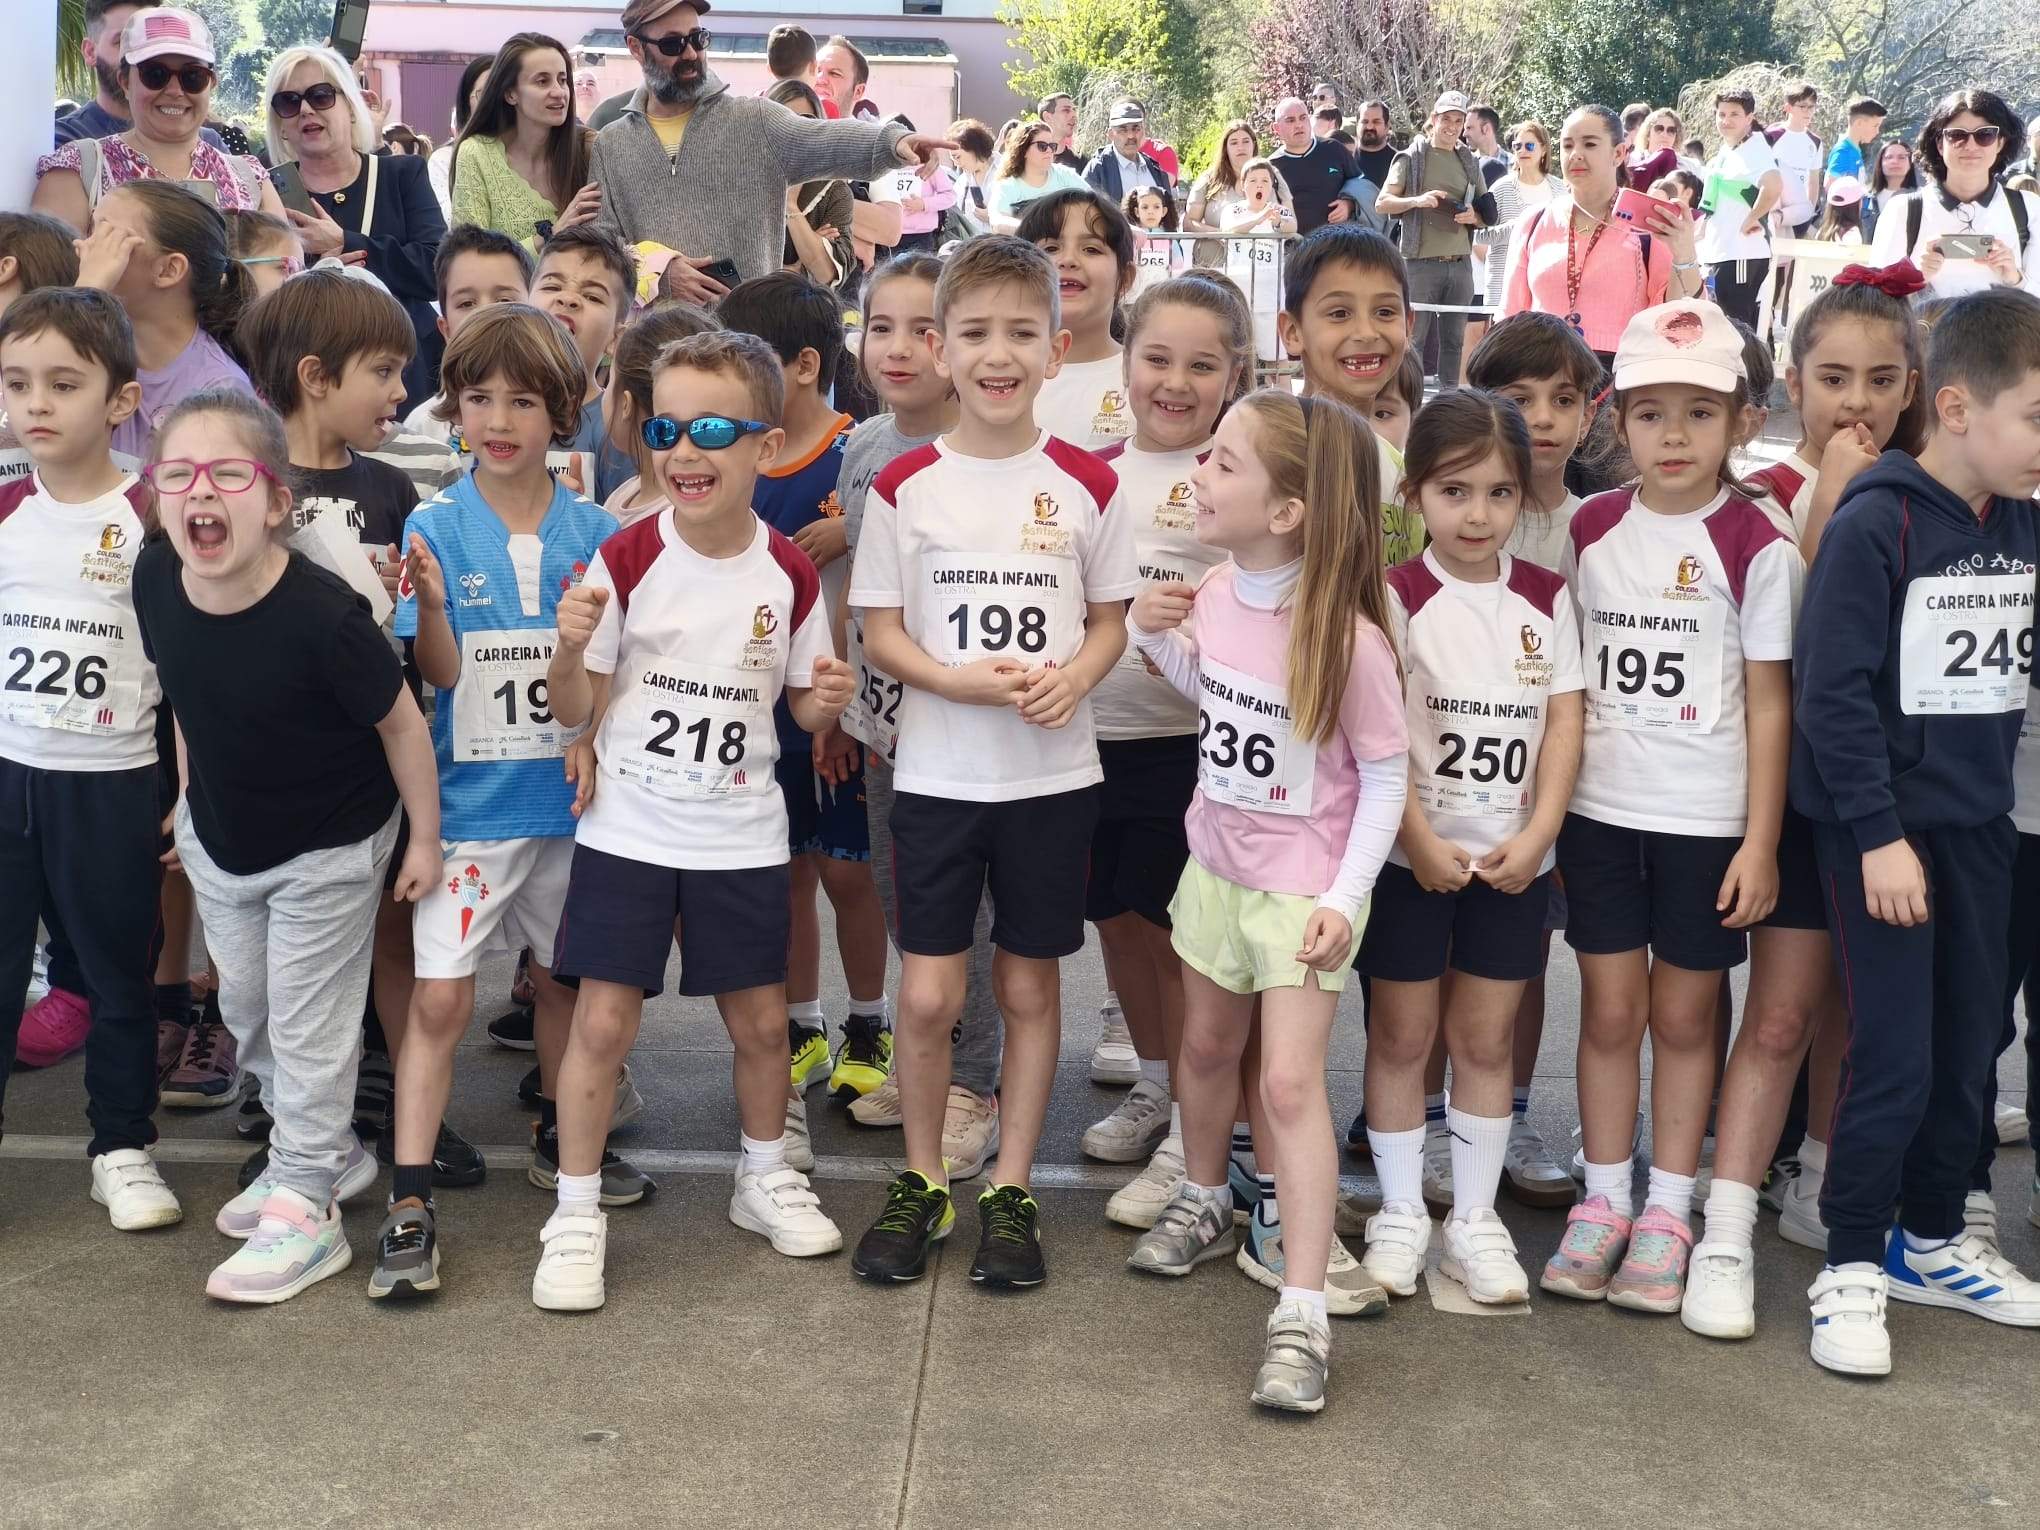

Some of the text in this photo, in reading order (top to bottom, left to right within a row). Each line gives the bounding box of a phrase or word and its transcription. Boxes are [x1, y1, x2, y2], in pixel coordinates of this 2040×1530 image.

[933, 570, 1059, 589] CARREIRA INFANTIL
[459, 595, 492, 607] hummel
[1926, 594, 1996, 610] CARREIRA
[65, 619, 125, 640] INFANTIL
[948, 603, 1047, 653] 198
[1640, 615, 1700, 633] INFANTIL
[474, 646, 541, 662] CARREIRA
[1943, 627, 2033, 677] 249
[4, 646, 108, 700] 226
[642, 671, 760, 702] CARREIRA INFANTIL
[1597, 645, 1685, 698] 195
[860, 665, 904, 727] 252
[1236, 691, 1292, 721] INFANTIL
[1426, 696, 1539, 720] CARREIRA INFANTIL
[644, 709, 747, 766] 218
[1199, 708, 1276, 778] 236
[1434, 732, 1528, 785] 250
